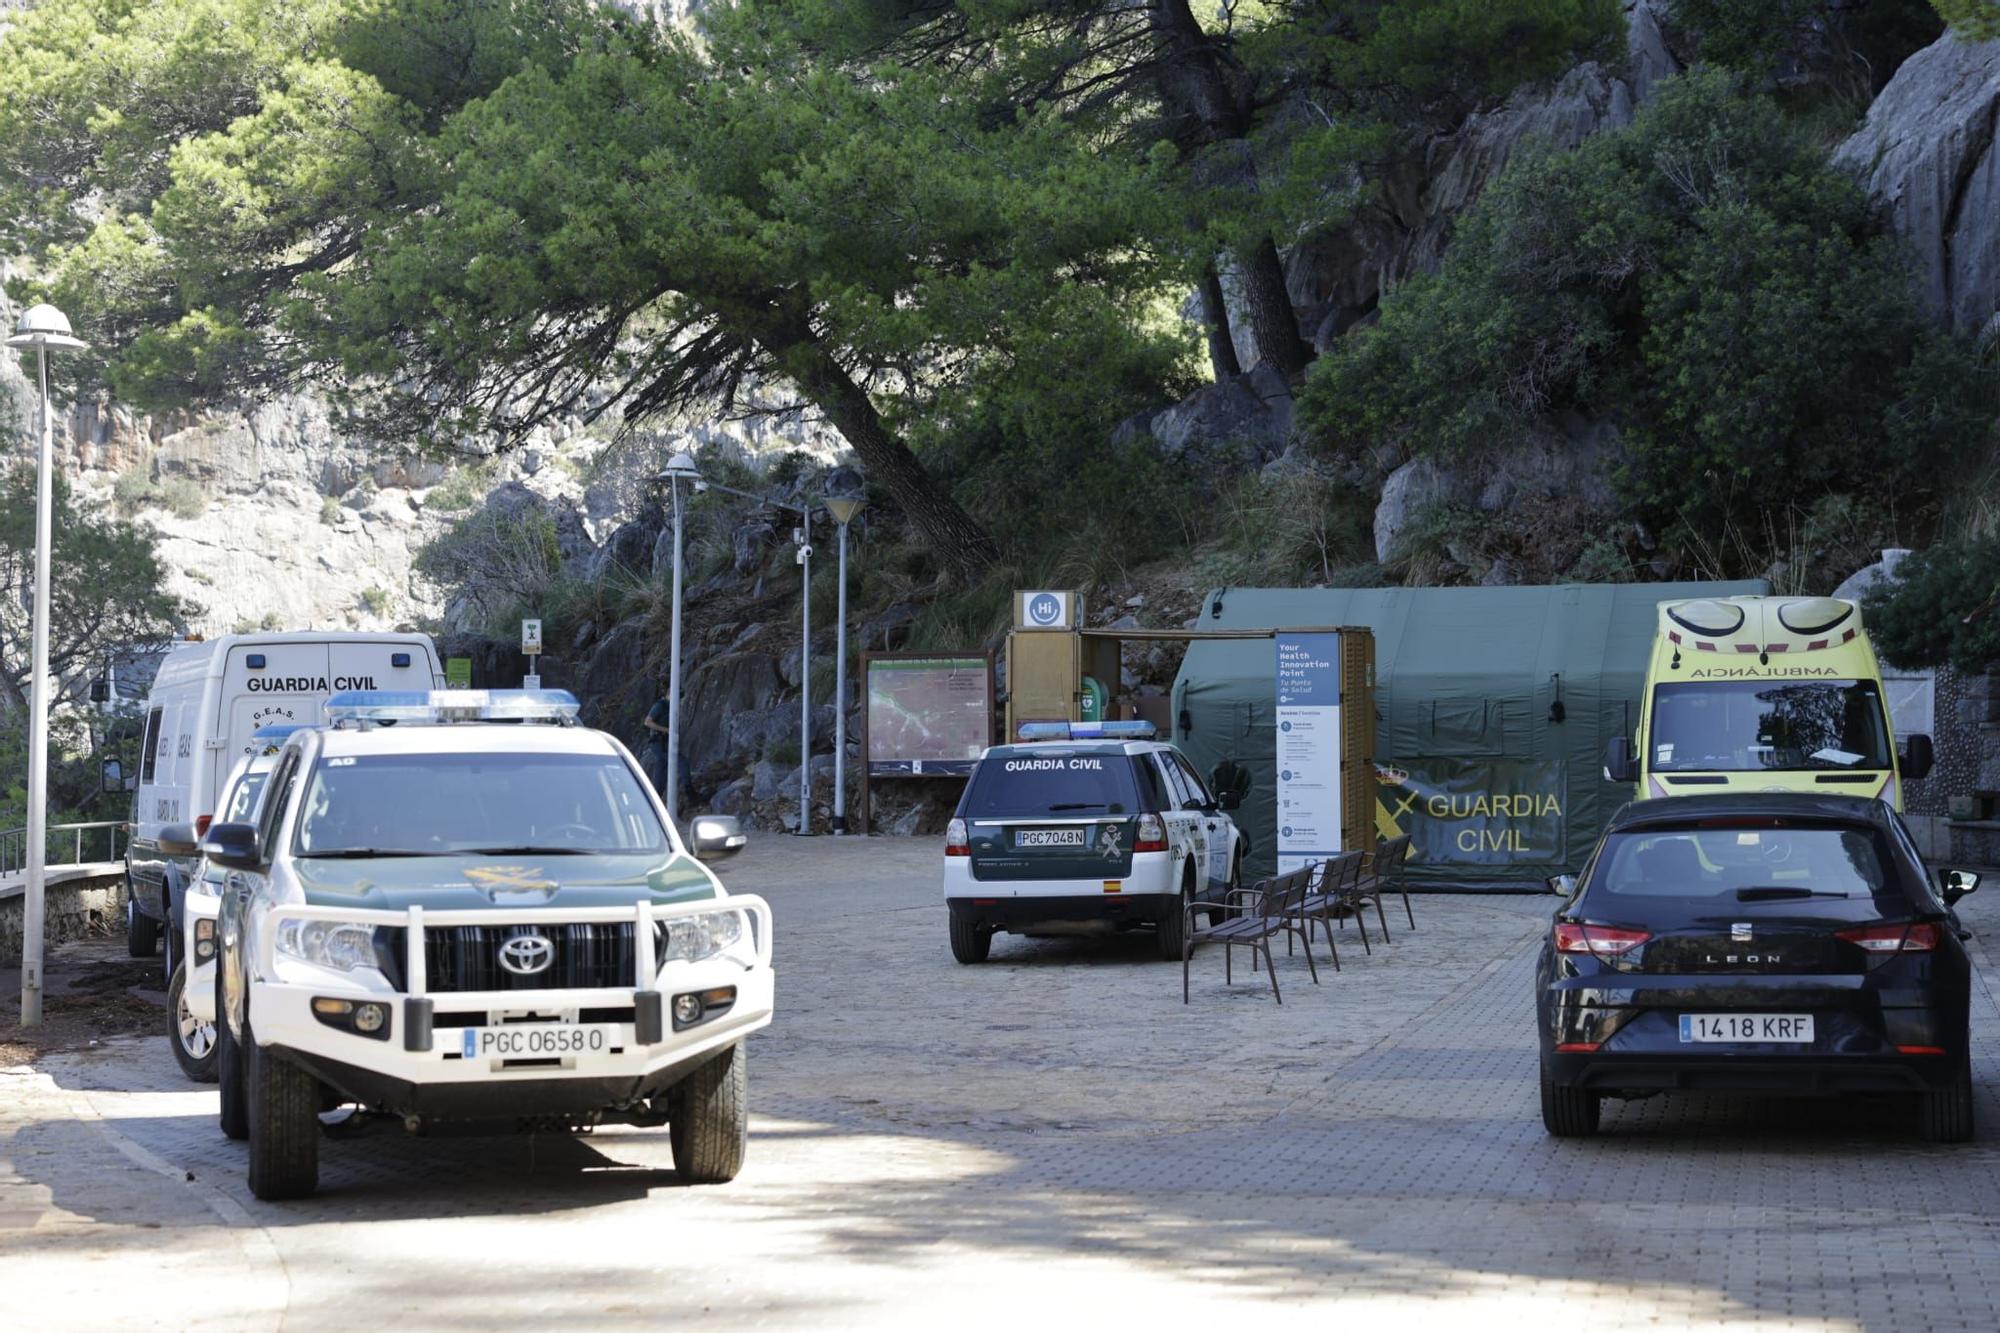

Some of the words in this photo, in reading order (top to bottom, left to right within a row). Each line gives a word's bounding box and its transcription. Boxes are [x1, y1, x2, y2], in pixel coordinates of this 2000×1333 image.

[1038, 601, 1052, 614] Hi
[1279, 644, 1299, 652] Your
[1279, 652, 1310, 660] Health
[1280, 660, 1330, 669] Innovation
[1280, 669, 1305, 677] Point
[247, 677, 328, 692] GUARDIA
[334, 676, 377, 691] CIVIL
[253, 707, 294, 720] G.E.A.S.
[1005, 759, 1065, 772] GUARDIA
[1069, 759, 1102, 770] CIVIL
[1427, 794, 1562, 818] GUARDIA
[1456, 829, 1530, 852] CIVIL
[1706, 955, 1780, 963] LEON
[1699, 1018, 1754, 1038] 1418
[1763, 1018, 1806, 1038] KRF
